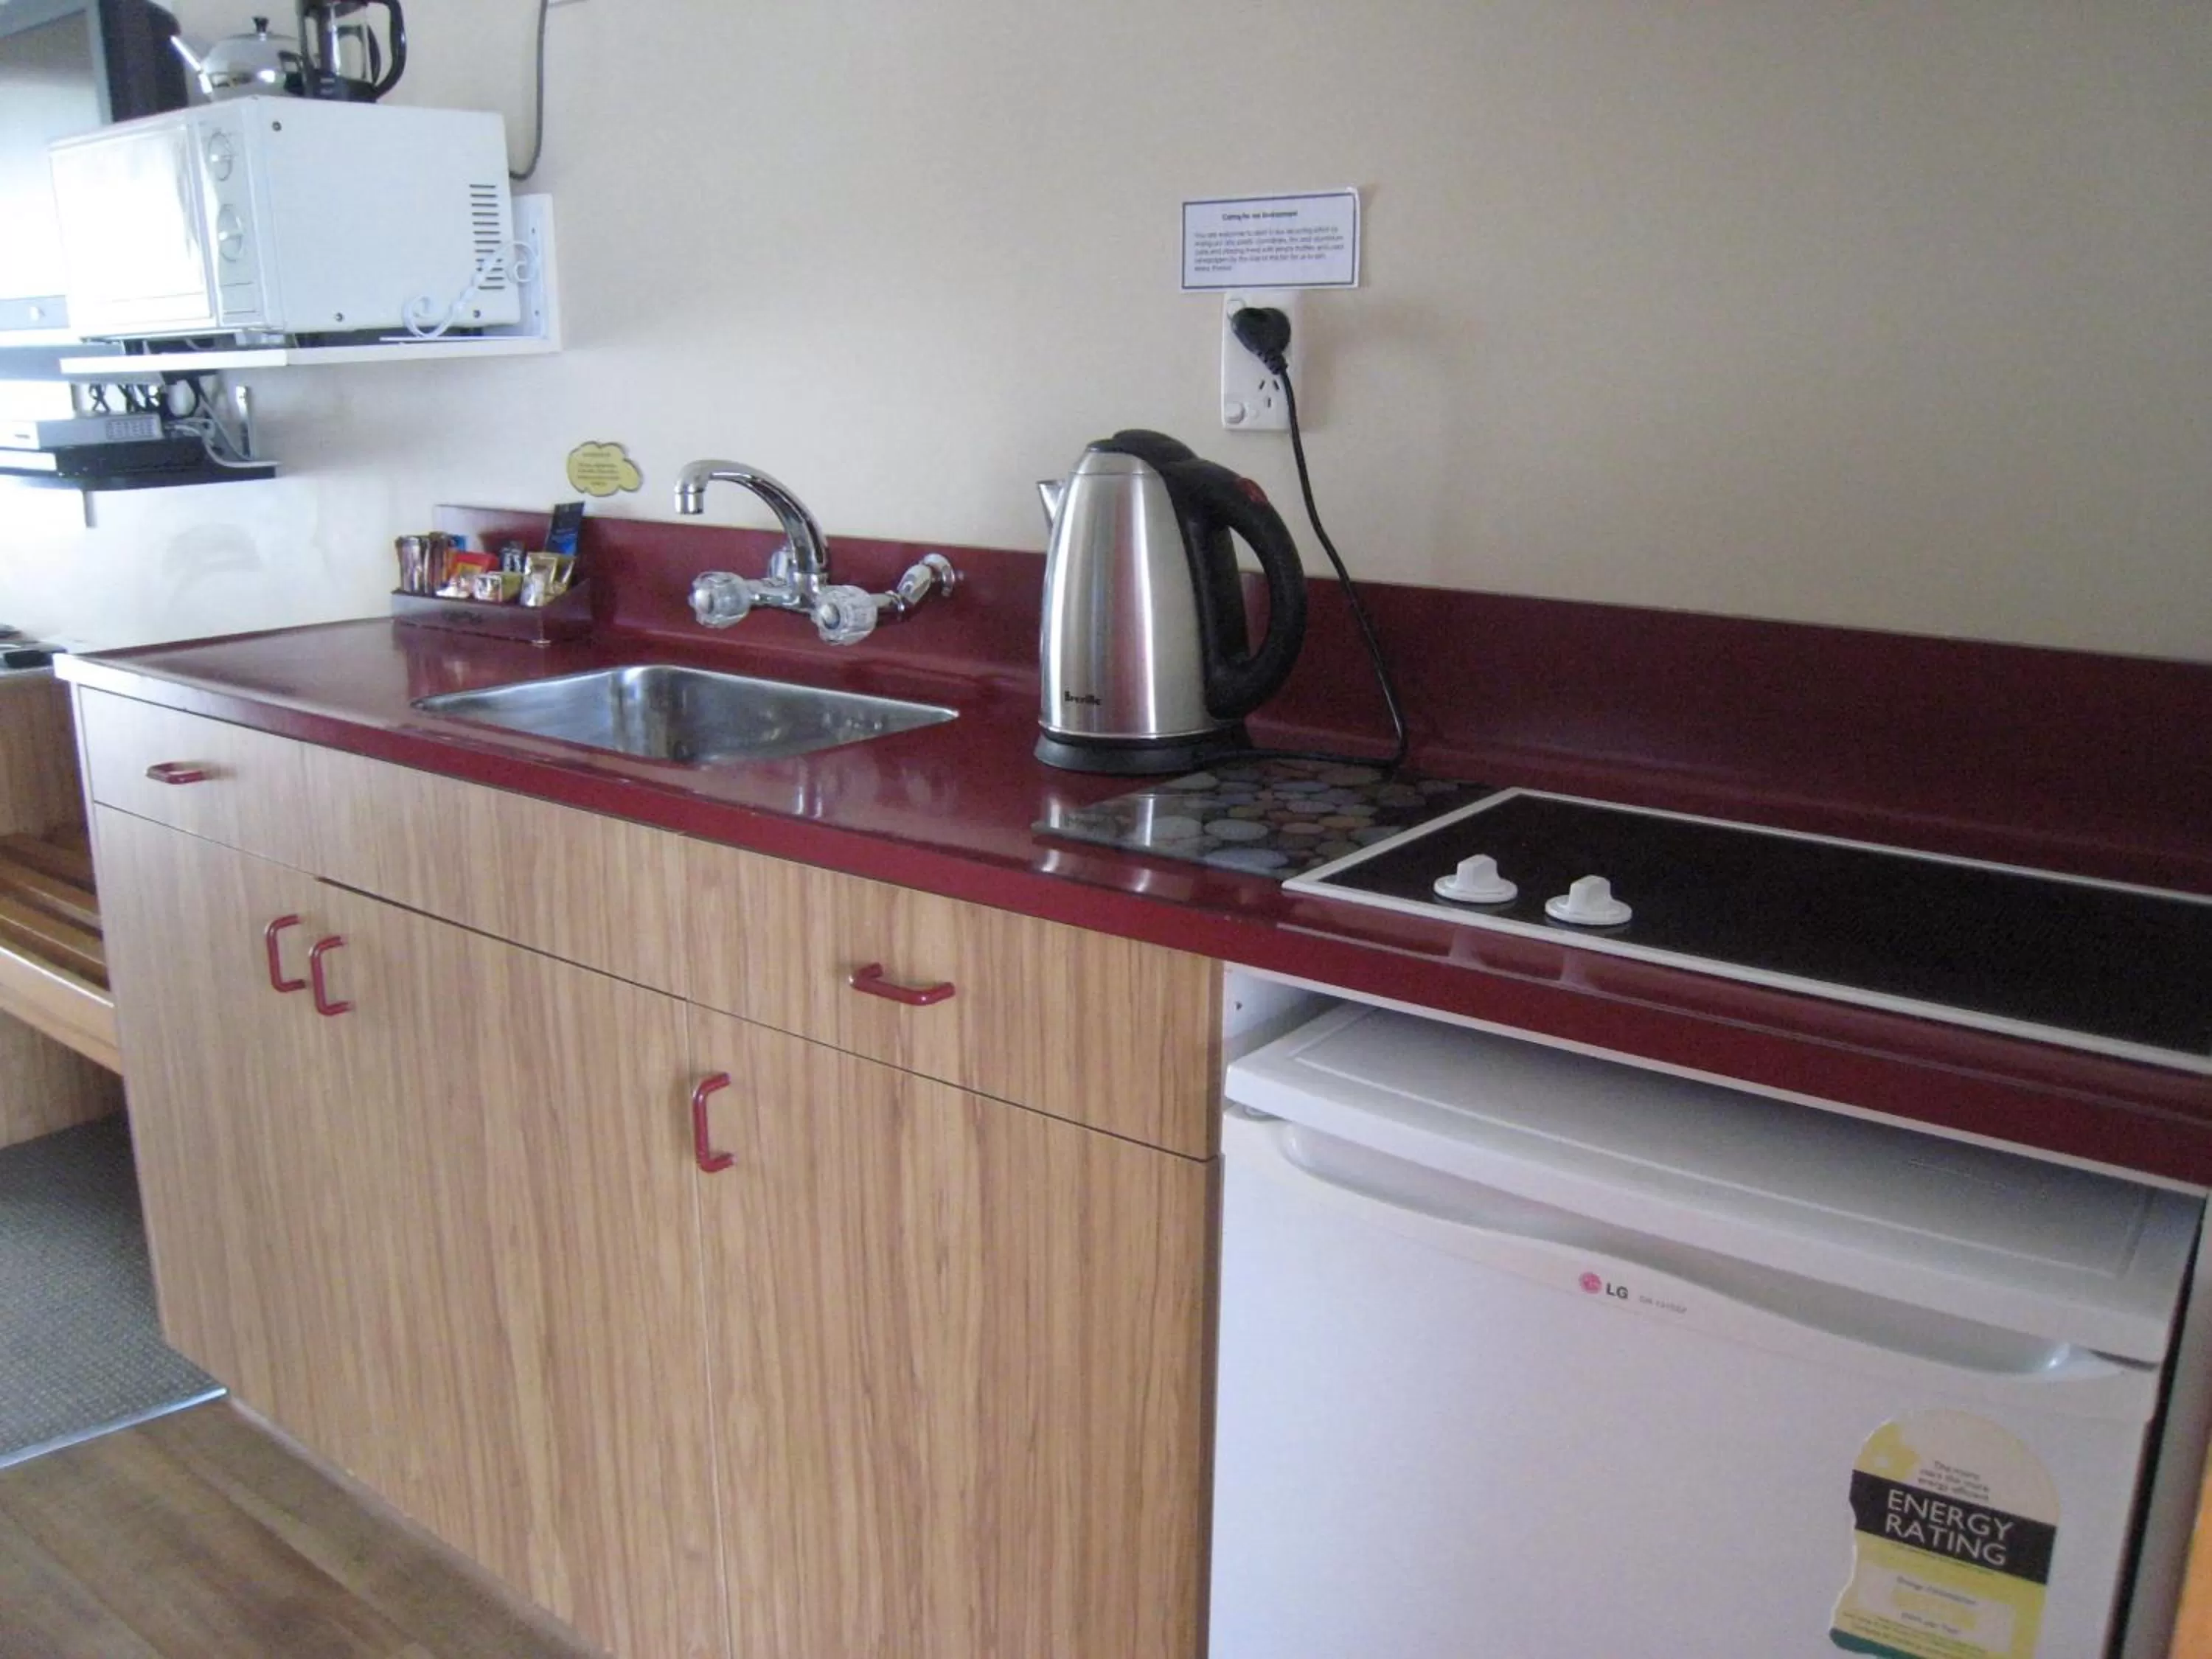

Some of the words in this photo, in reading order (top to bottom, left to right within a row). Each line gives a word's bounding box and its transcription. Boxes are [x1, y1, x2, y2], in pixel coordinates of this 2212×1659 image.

[1606, 1281, 1629, 1300] LG
[1885, 1513, 2007, 1567] RATING
[1887, 1488, 2014, 1541] ENERGY
